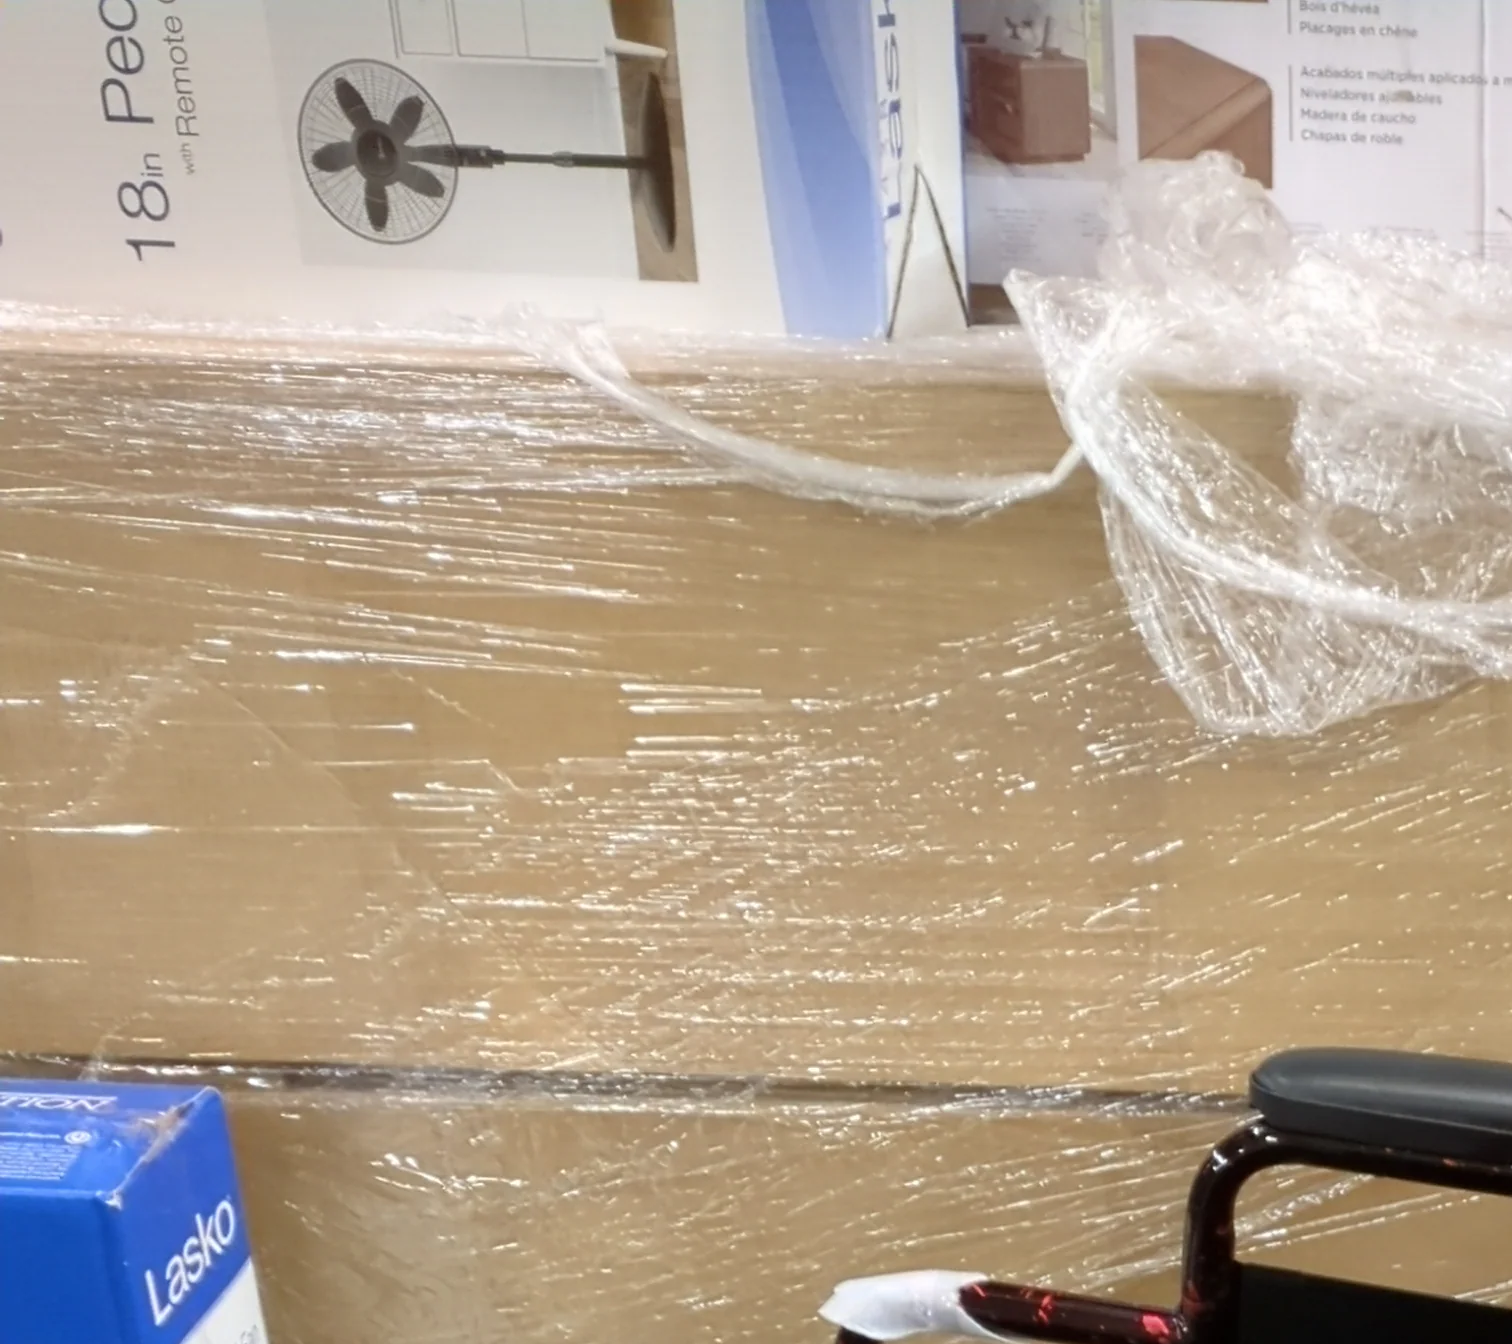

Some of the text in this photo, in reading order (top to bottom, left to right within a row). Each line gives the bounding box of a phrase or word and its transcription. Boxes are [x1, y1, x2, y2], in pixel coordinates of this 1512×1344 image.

[1299, 21, 1418, 38] Placages en chêne
[1300, 65, 1363, 80] Acabados
[1366, 67, 1425, 83] múltiples
[1428, 71, 1488, 88] aplicados
[164, 15, 199, 175] with Remote
[1300, 87, 1374, 101] Niveladores
[1300, 107, 1417, 125] Madera de caucho
[1301, 129, 1404, 144] Chapas de roble
[117, 153, 175, 261] 18in
[145, 1200, 235, 1326] Lasko
